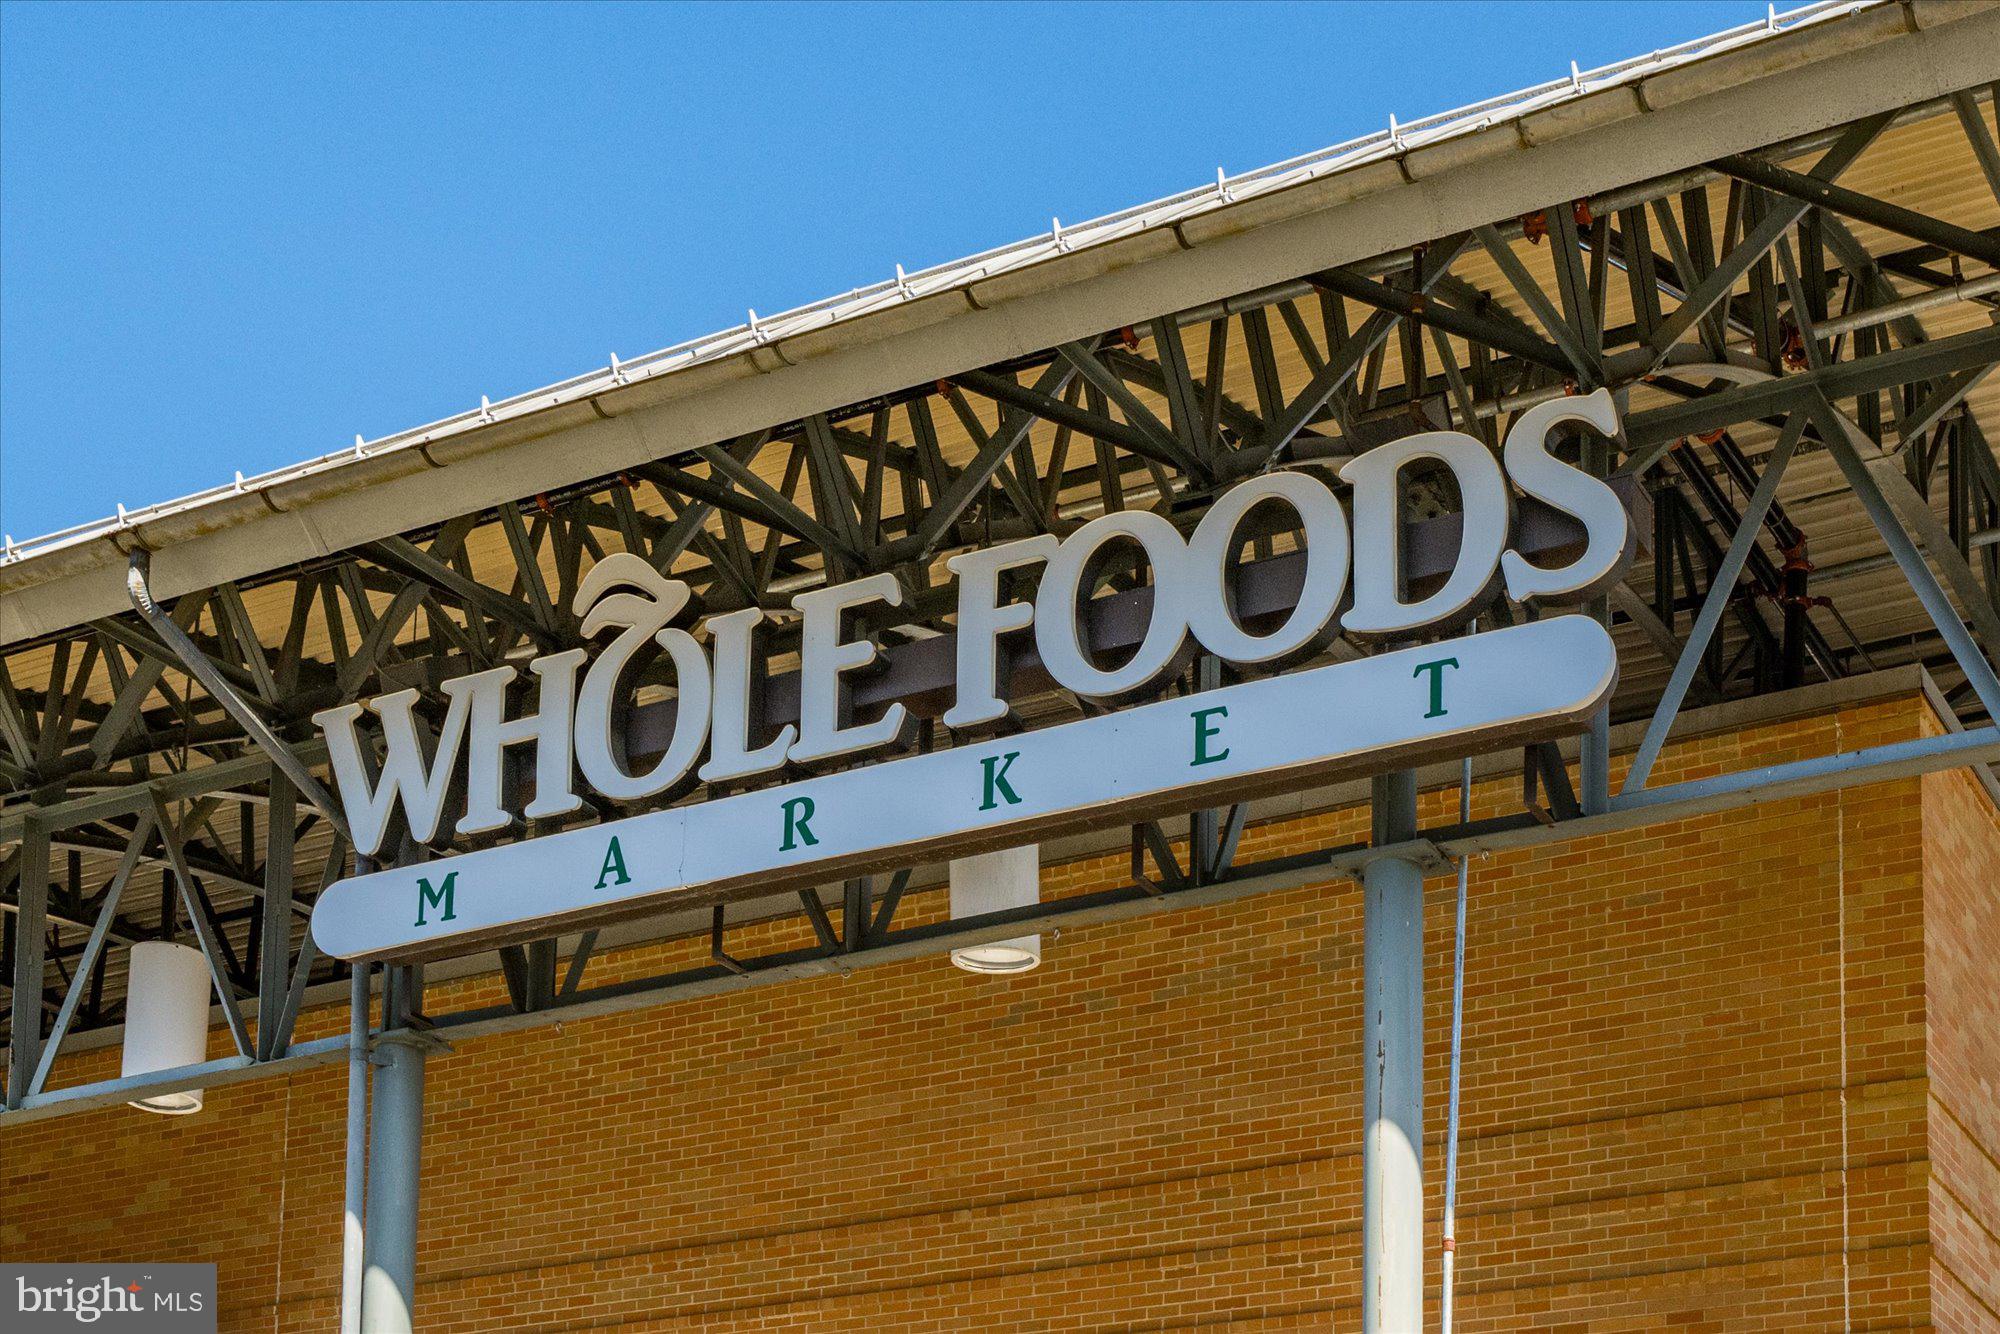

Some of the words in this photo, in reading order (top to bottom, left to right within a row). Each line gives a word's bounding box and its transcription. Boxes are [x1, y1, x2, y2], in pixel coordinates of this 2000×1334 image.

[312, 552, 908, 856] WHOLE
[943, 387, 1629, 729] FOODS
[413, 656, 1460, 928] MARKET
